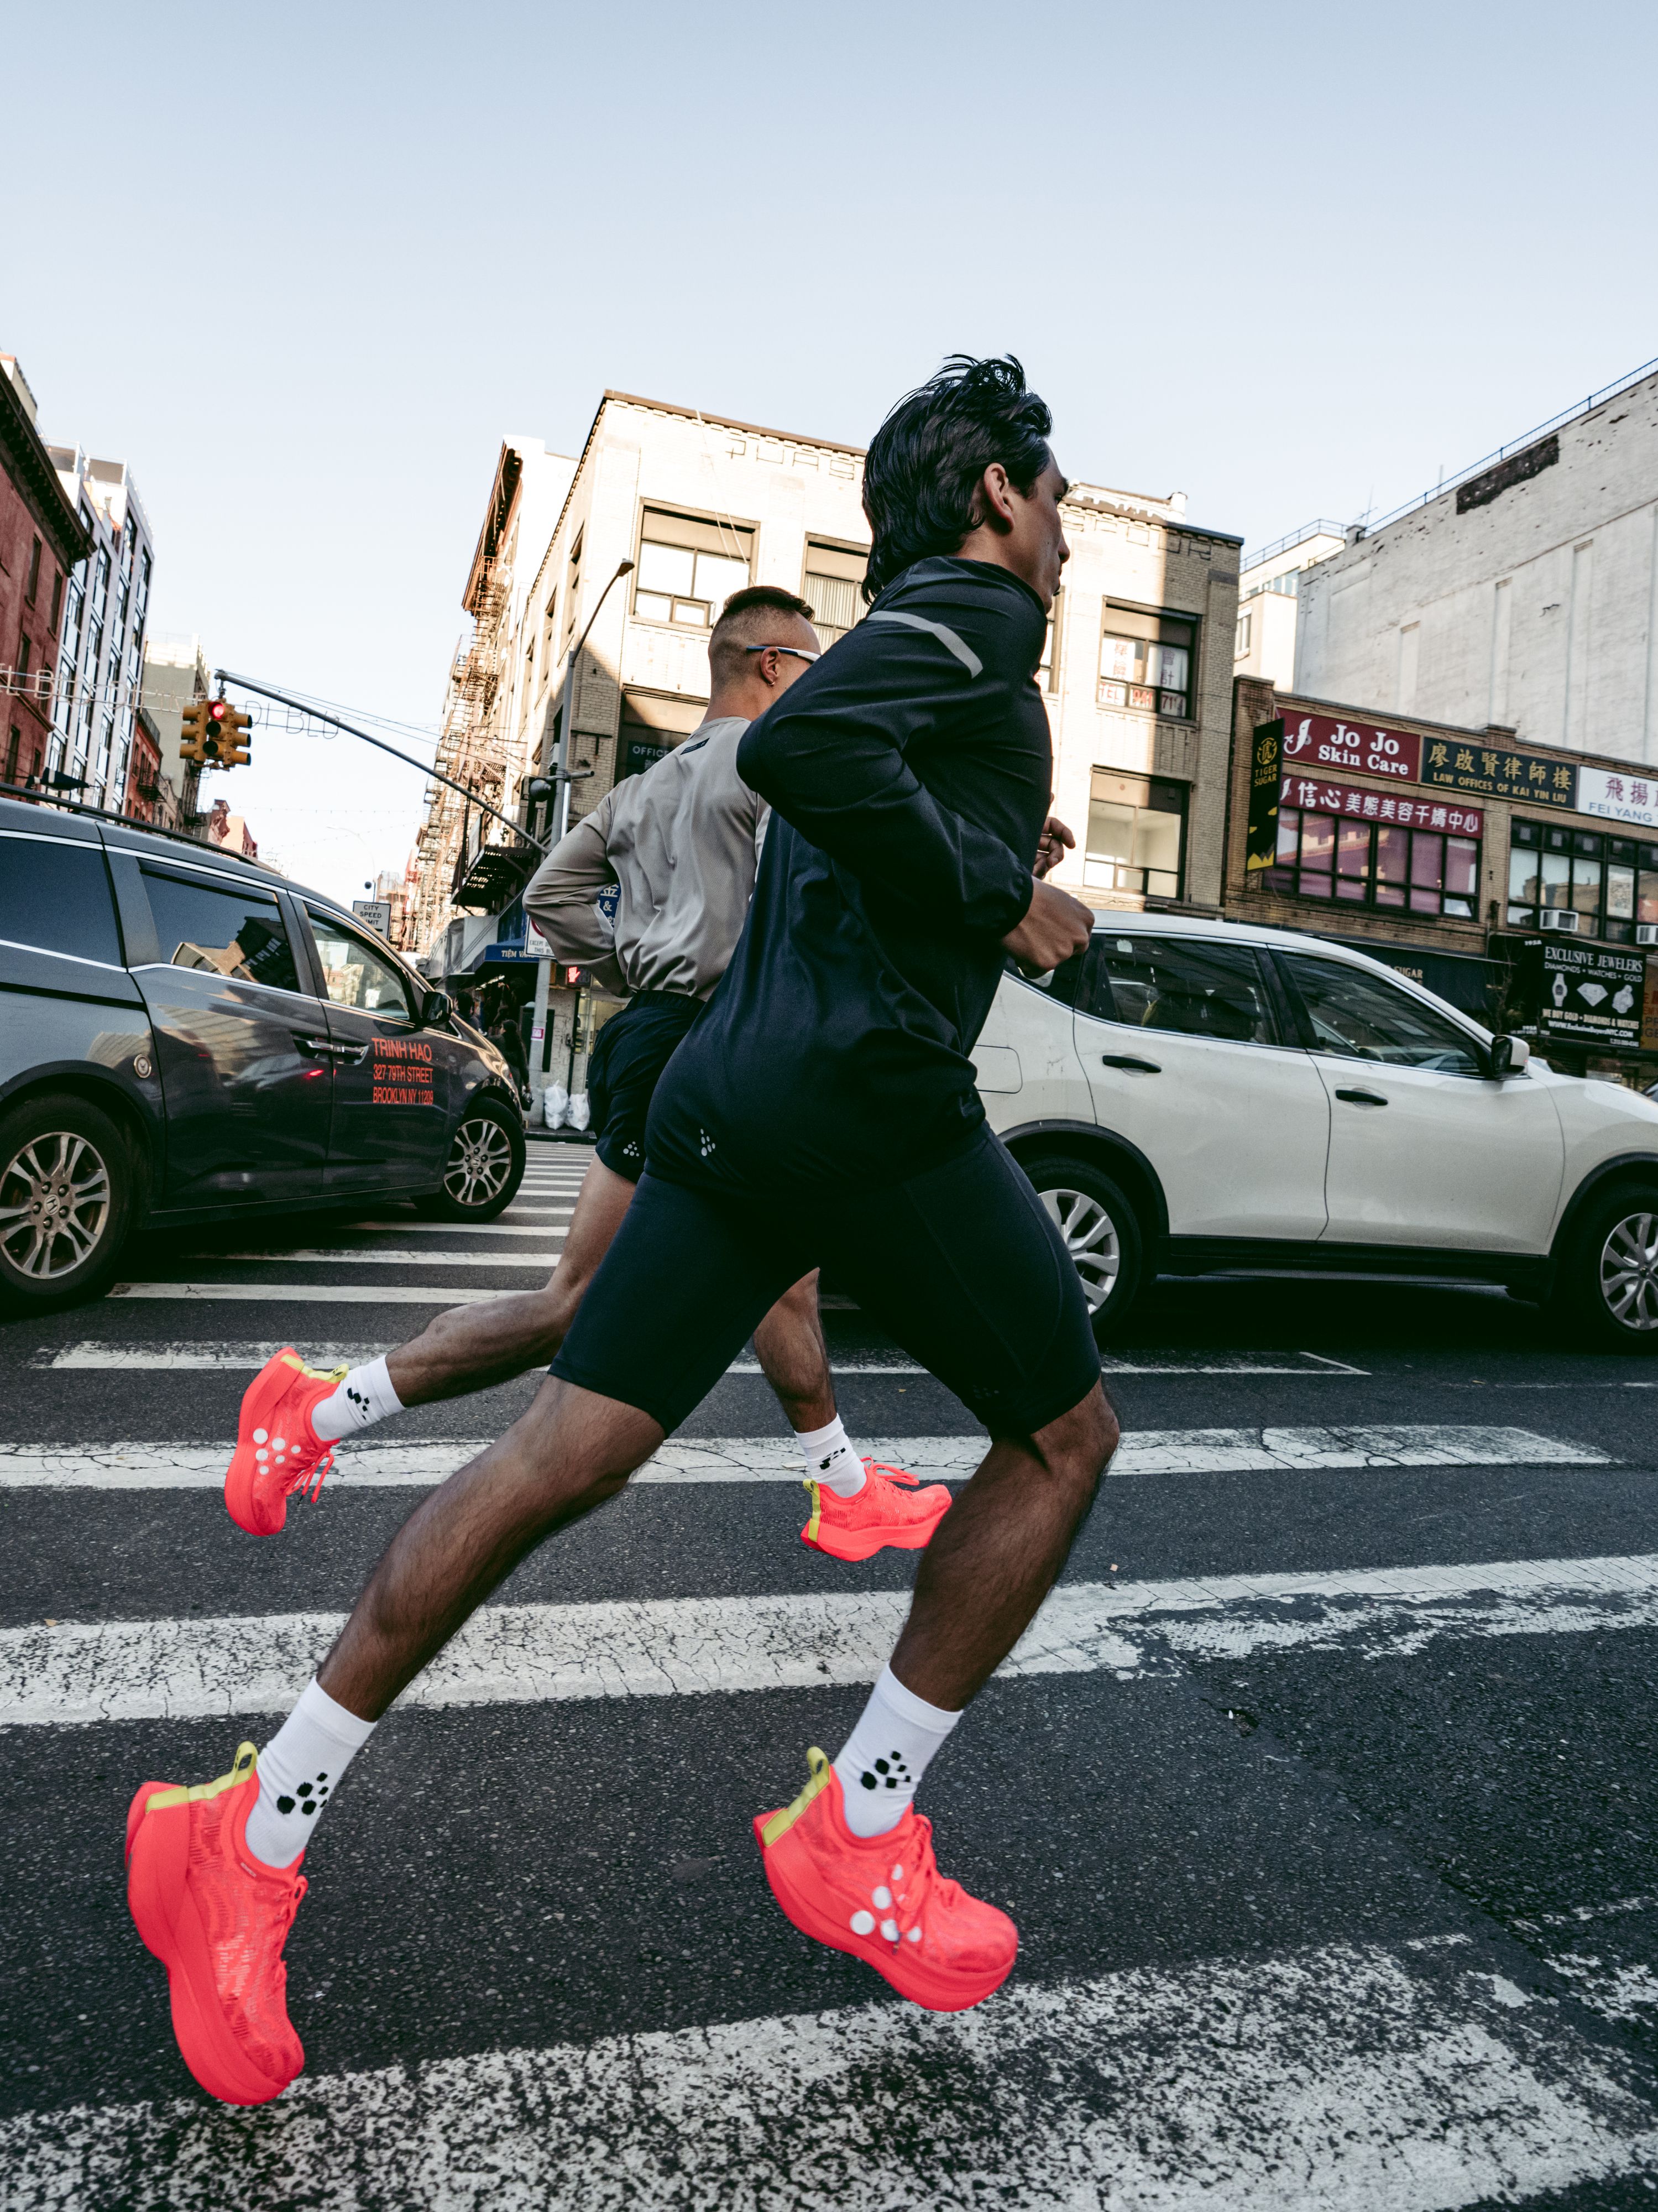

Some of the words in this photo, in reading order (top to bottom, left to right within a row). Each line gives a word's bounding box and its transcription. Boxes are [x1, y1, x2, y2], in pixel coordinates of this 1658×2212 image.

[1330, 724, 1360, 747] Jo
[1370, 732, 1399, 755] Jo
[1318, 744, 1361, 766] Skin
[1367, 754, 1409, 775] Care
[1254, 773, 1277, 787] SUGAR
[1255, 764, 1277, 778] TIGER
[1433, 772, 1454, 784] LAW
[1458, 776, 1493, 791] OFFICES
[1497, 782, 1509, 793] OF
[1513, 786, 1529, 797] KAI
[1534, 789, 1549, 800] YIN
[1552, 792, 1567, 803] LIU
[1605, 776, 1658, 809] 飛揚
[1589, 802, 1610, 815] FEI
[1615, 806, 1652, 822] YANG
[1545, 946, 1594, 966] EXCLUSIVE
[1597, 955, 1643, 972] JEWELERS
[1544, 962, 1581, 973] DIAMONDS
[1587, 969, 1618, 979] WATCHES
[1624, 974, 1643, 982] GOLD
[372, 1037, 407, 1059] TRINH
[409, 1042, 432, 1062] HAO
[373, 1063, 386, 1080] 327
[388, 1065, 406, 1081] 79TH
[407, 1066, 433, 1083] STREET
[373, 1087, 407, 1104] BROOKLYN
[409, 1088, 417, 1104] NY
